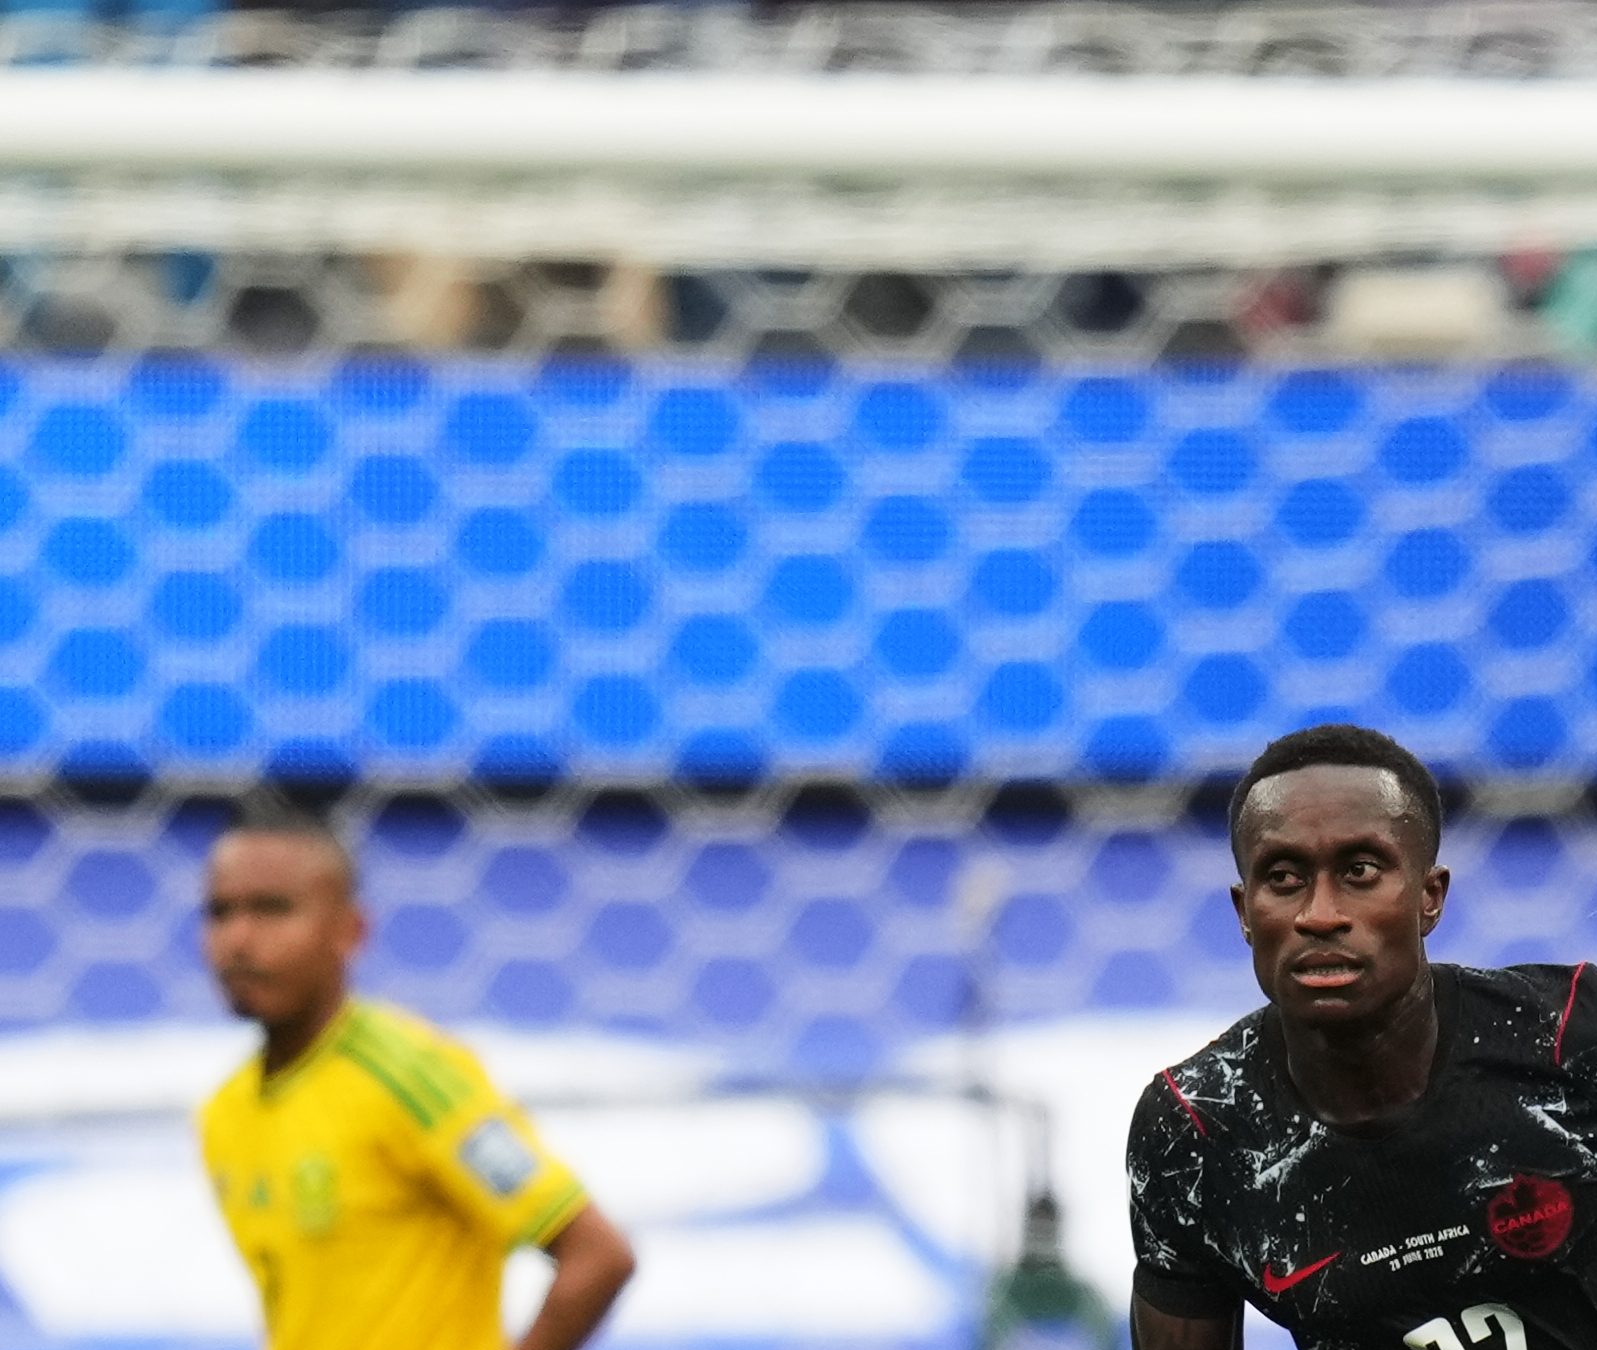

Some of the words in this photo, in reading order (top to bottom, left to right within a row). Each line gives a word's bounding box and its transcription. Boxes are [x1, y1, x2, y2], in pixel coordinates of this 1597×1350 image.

[1493, 1201, 1568, 1233] CANADA
[1360, 1244, 1397, 1265] CANADA
[1405, 1233, 1435, 1249] SOUTH
[1438, 1224, 1470, 1241] AFRICA
